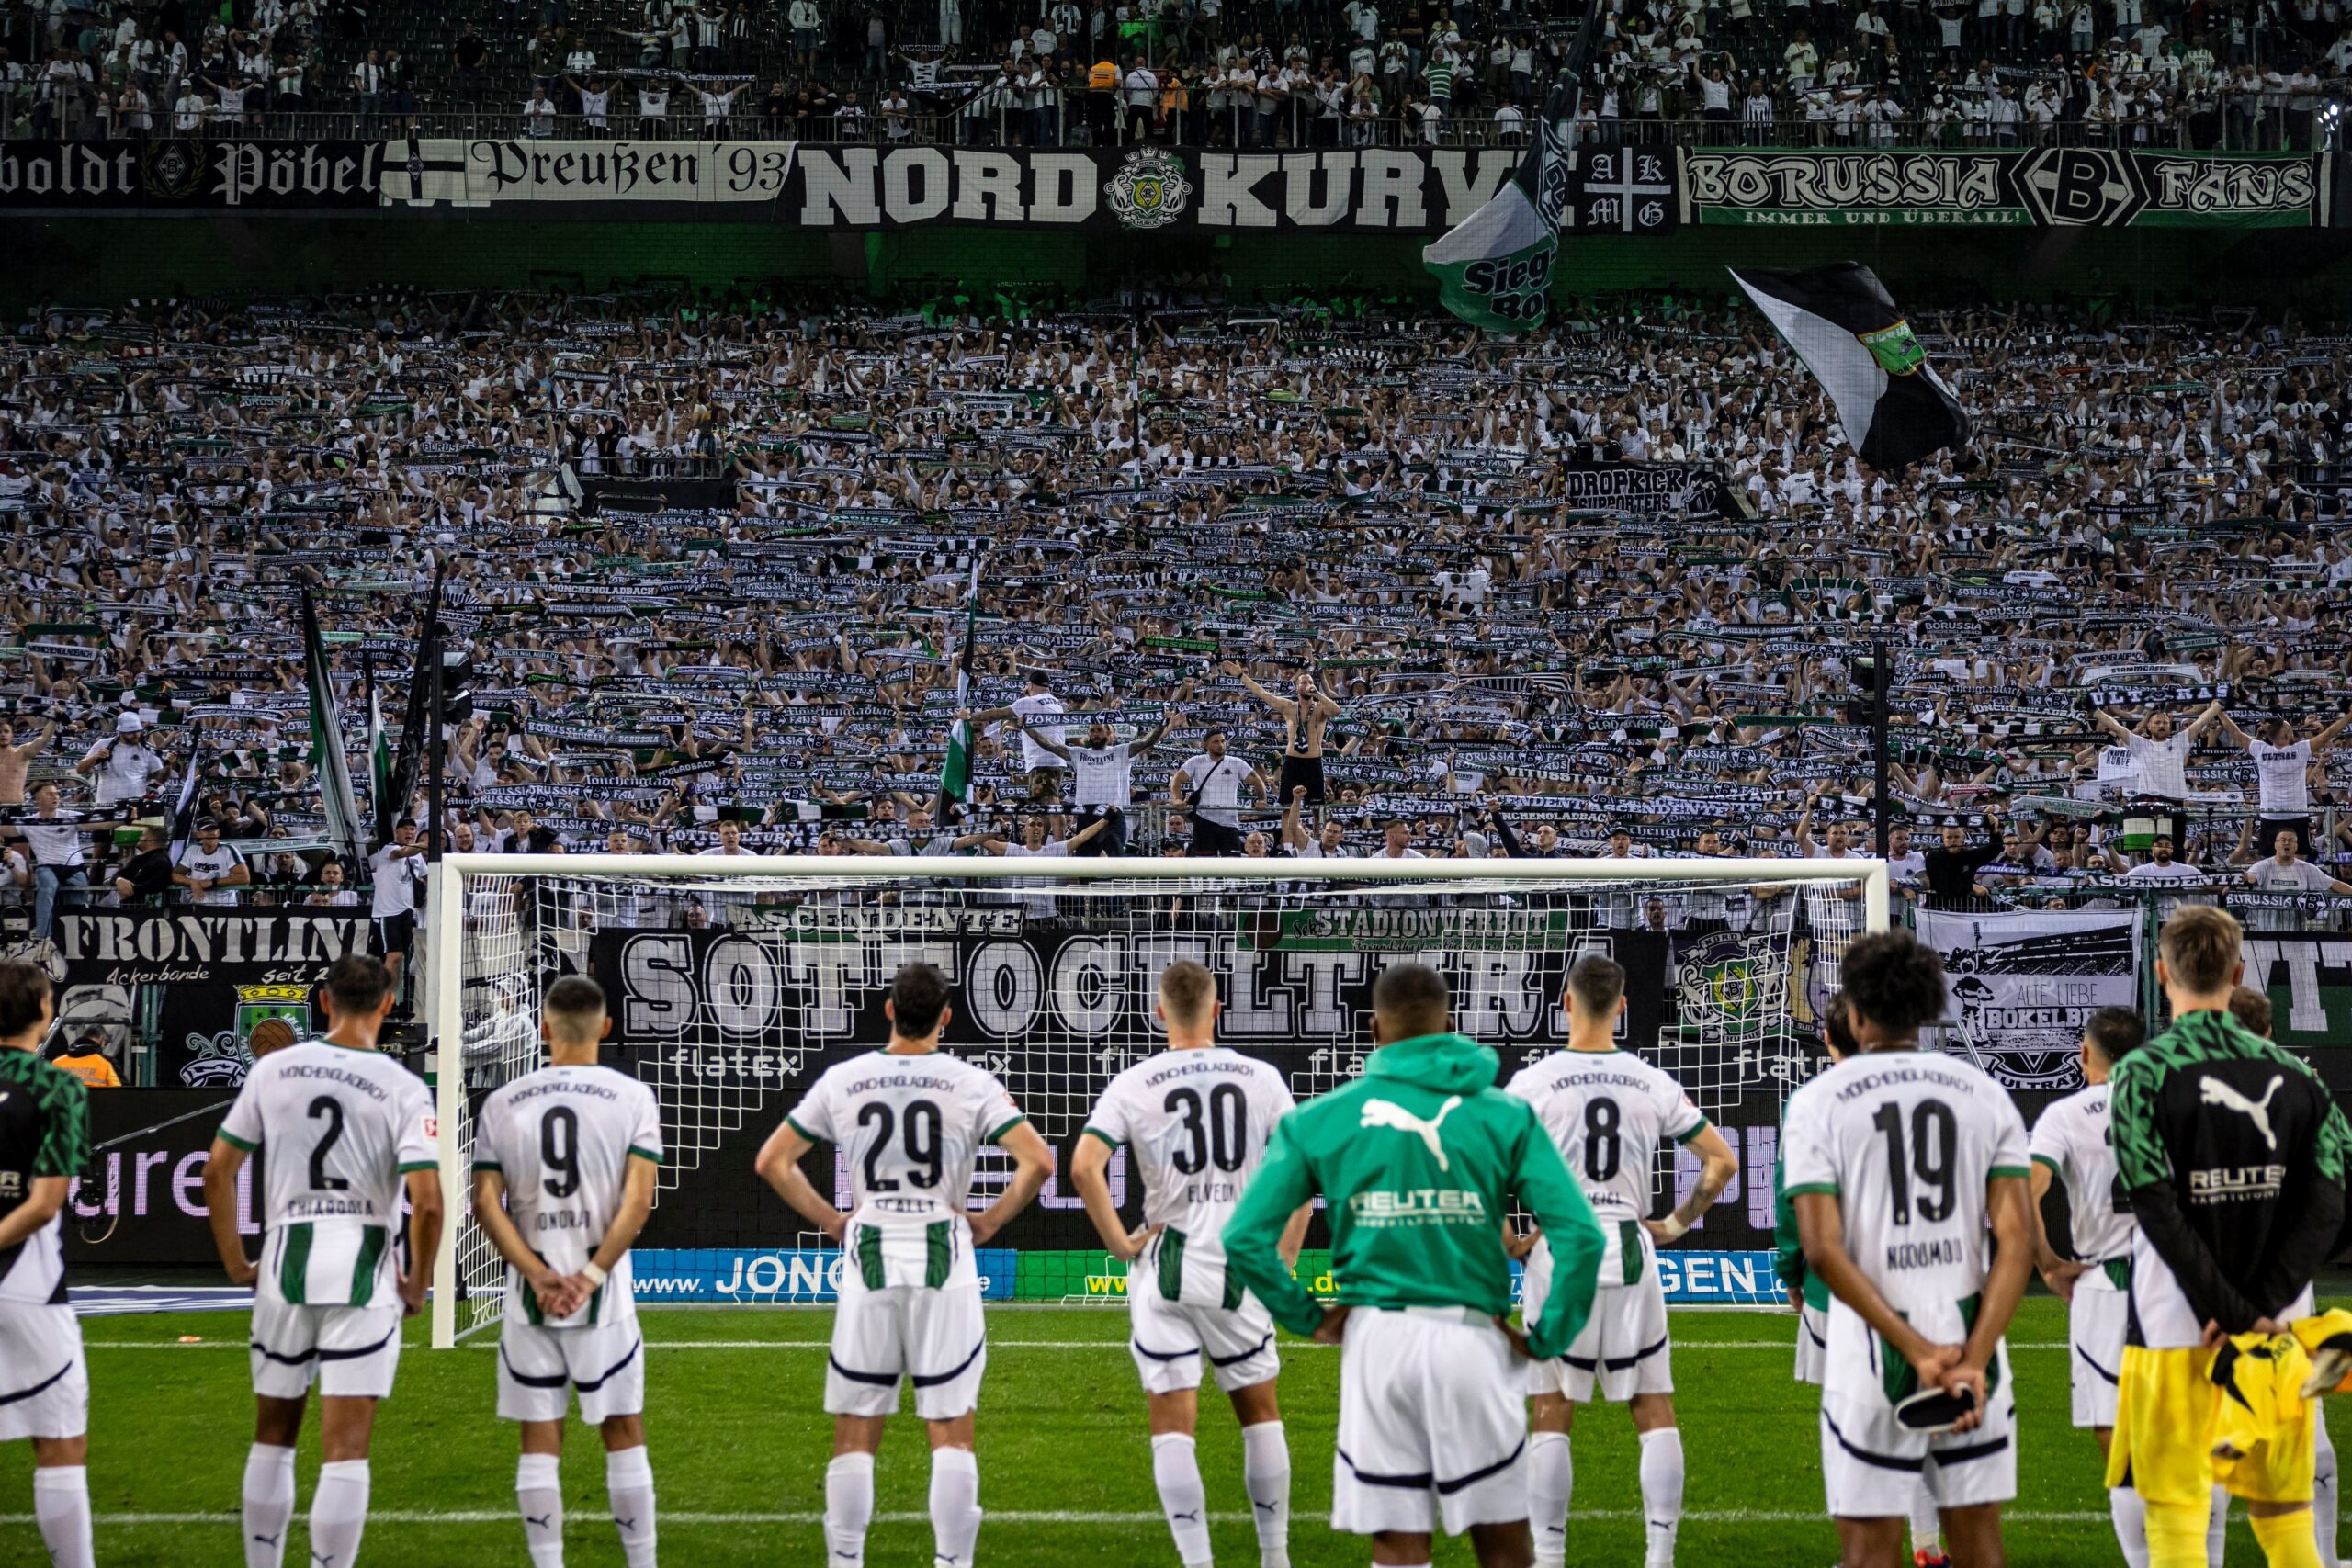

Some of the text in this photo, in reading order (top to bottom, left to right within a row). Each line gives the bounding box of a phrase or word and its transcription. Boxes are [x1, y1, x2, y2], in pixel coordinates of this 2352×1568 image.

[209, 142, 379, 206] Pöbel
[799, 148, 1578, 227] NORD KURV
[1687, 154, 2000, 210] BORUSSIA
[2154, 161, 2315, 213] FANS
[1745, 210, 2021, 225] IMMER UND ÜBERALL!
[1462, 248, 1552, 295] Sieg
[1567, 468, 1685, 498] DROPKICK
[1577, 493, 1672, 514] SUPPORTERS
[1025, 711, 1164, 725] BORUSSIA FANS
[2261, 750, 2296, 761] ULTRAS
[2087, 872, 2245, 890] ASCENDENTE
[2226, 894, 2293, 907] BORUSSIA
[737, 906, 1023, 937] ASCENDENTE
[1705, 932, 1738, 945] NORD
[106, 964, 209, 986] Ackerbande
[261, 965, 307, 985] seit
[2017, 983, 2048, 1006] ALTE
[2058, 983, 2098, 1006] LIEBE
[307, 1095, 348, 1190] 2
[1163, 1081, 1248, 1176] 30
[1584, 1096, 1621, 1182] 8
[541, 1105, 580, 1199] 9
[857, 1100, 943, 1191] 29
[1871, 1099, 1959, 1226] 19
